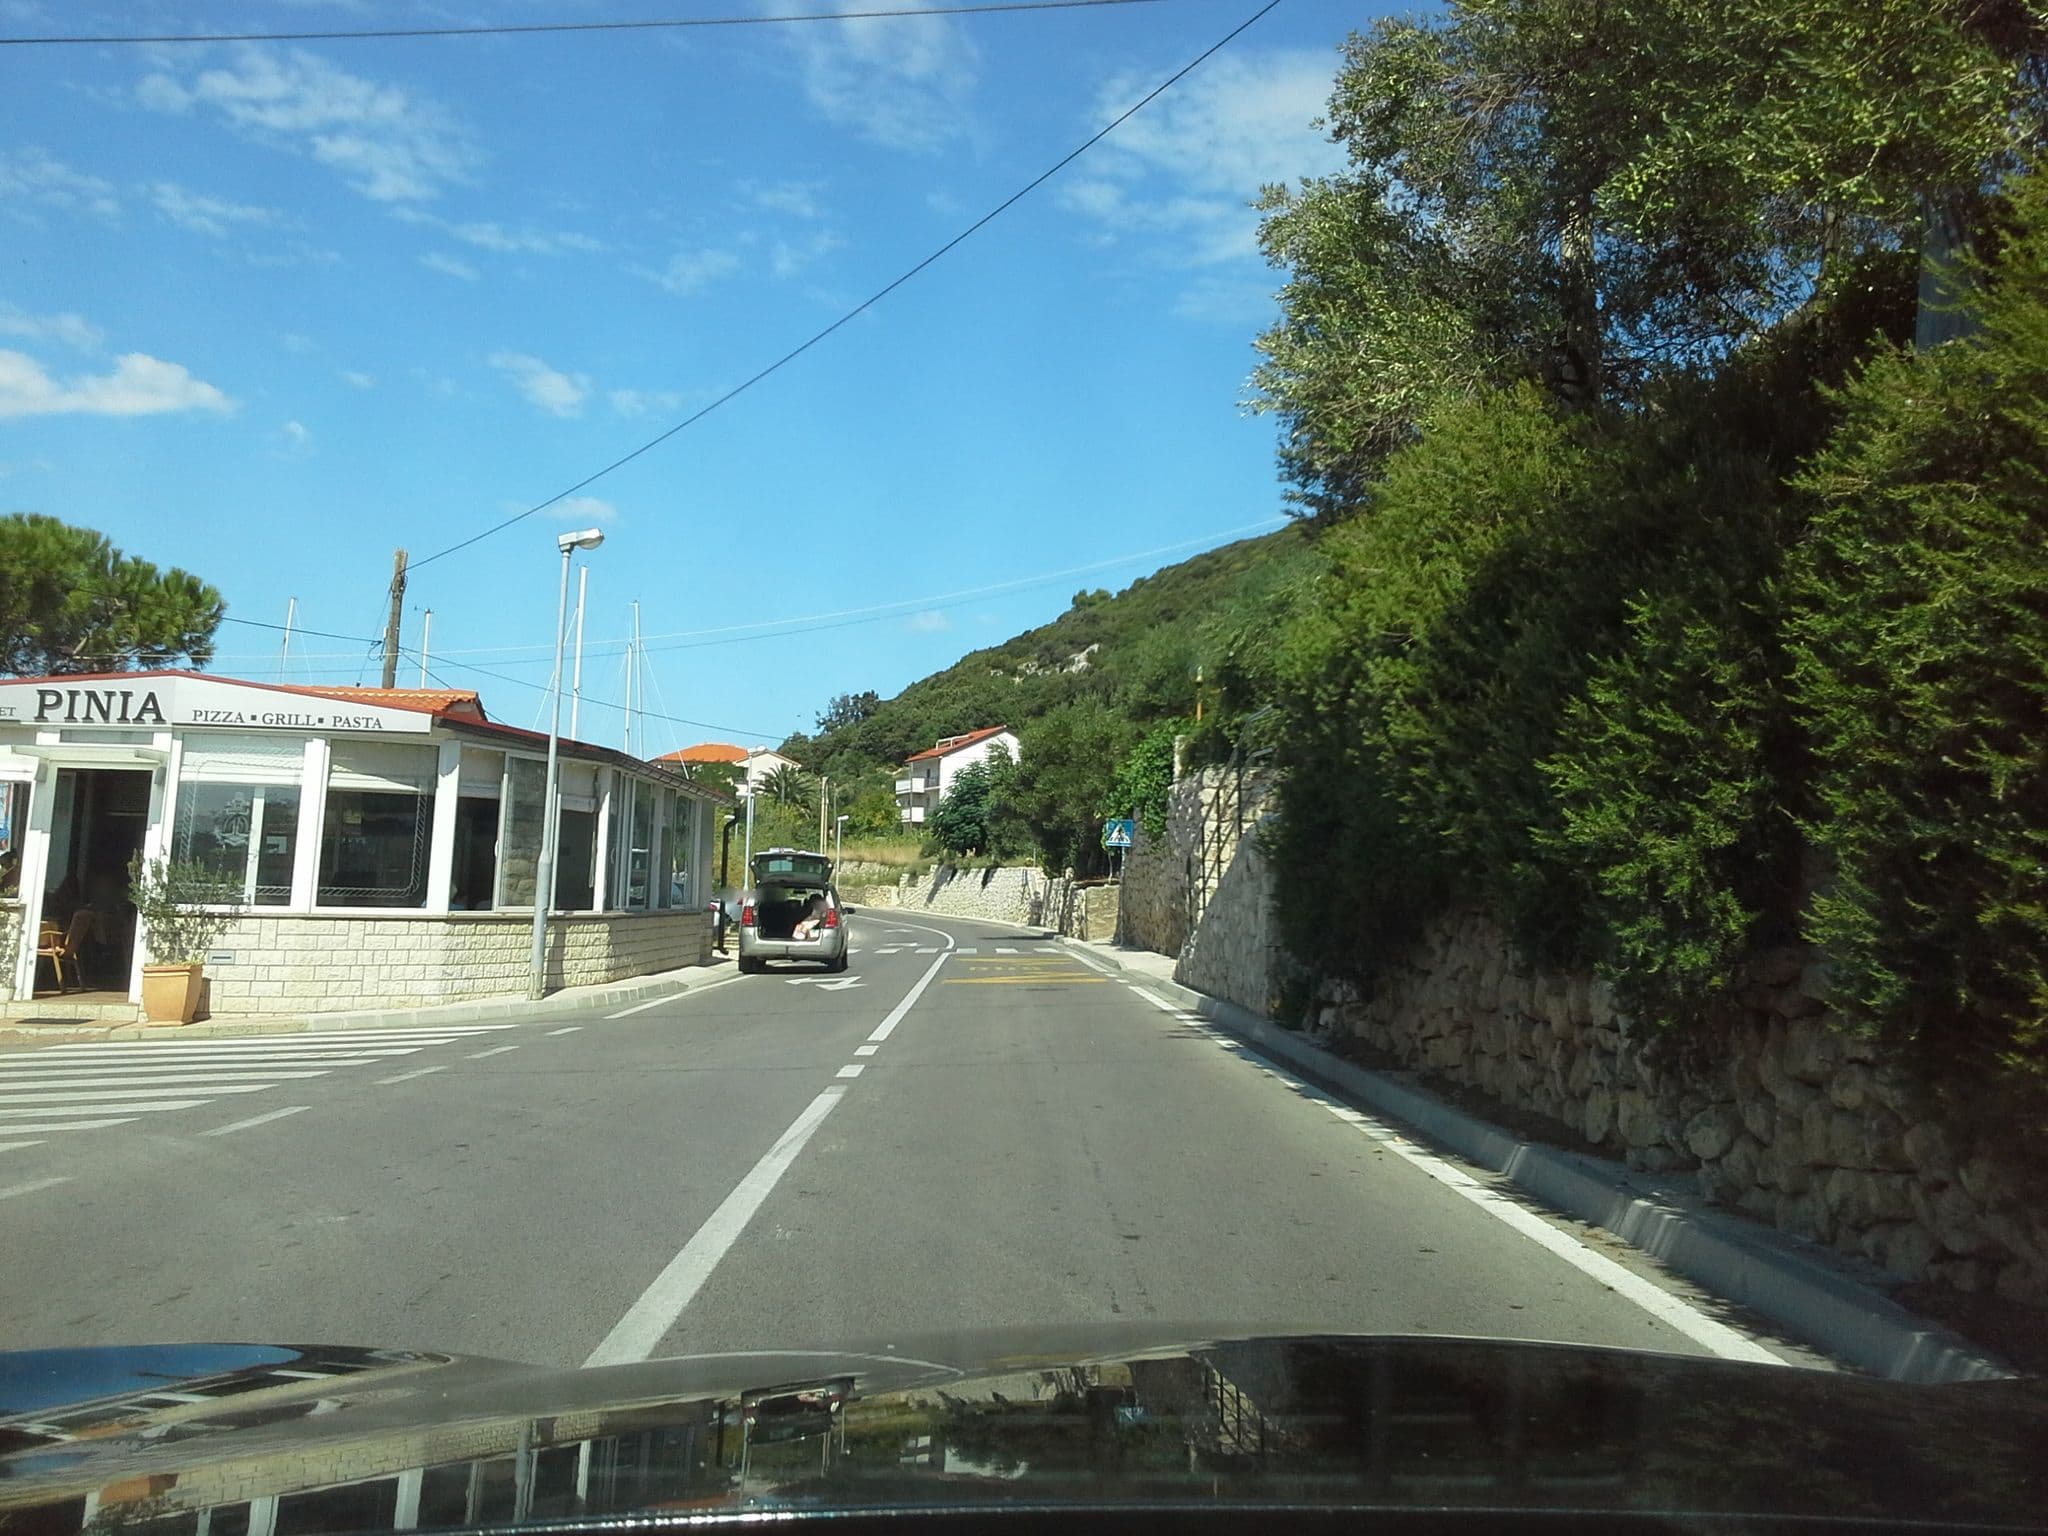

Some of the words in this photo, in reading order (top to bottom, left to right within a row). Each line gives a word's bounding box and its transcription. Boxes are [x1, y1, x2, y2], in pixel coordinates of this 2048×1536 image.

[34, 689, 167, 724] PINIA
[192, 709, 245, 724] PIZZA
[261, 712, 316, 727] GRILL
[332, 716, 383, 729] PASTA
